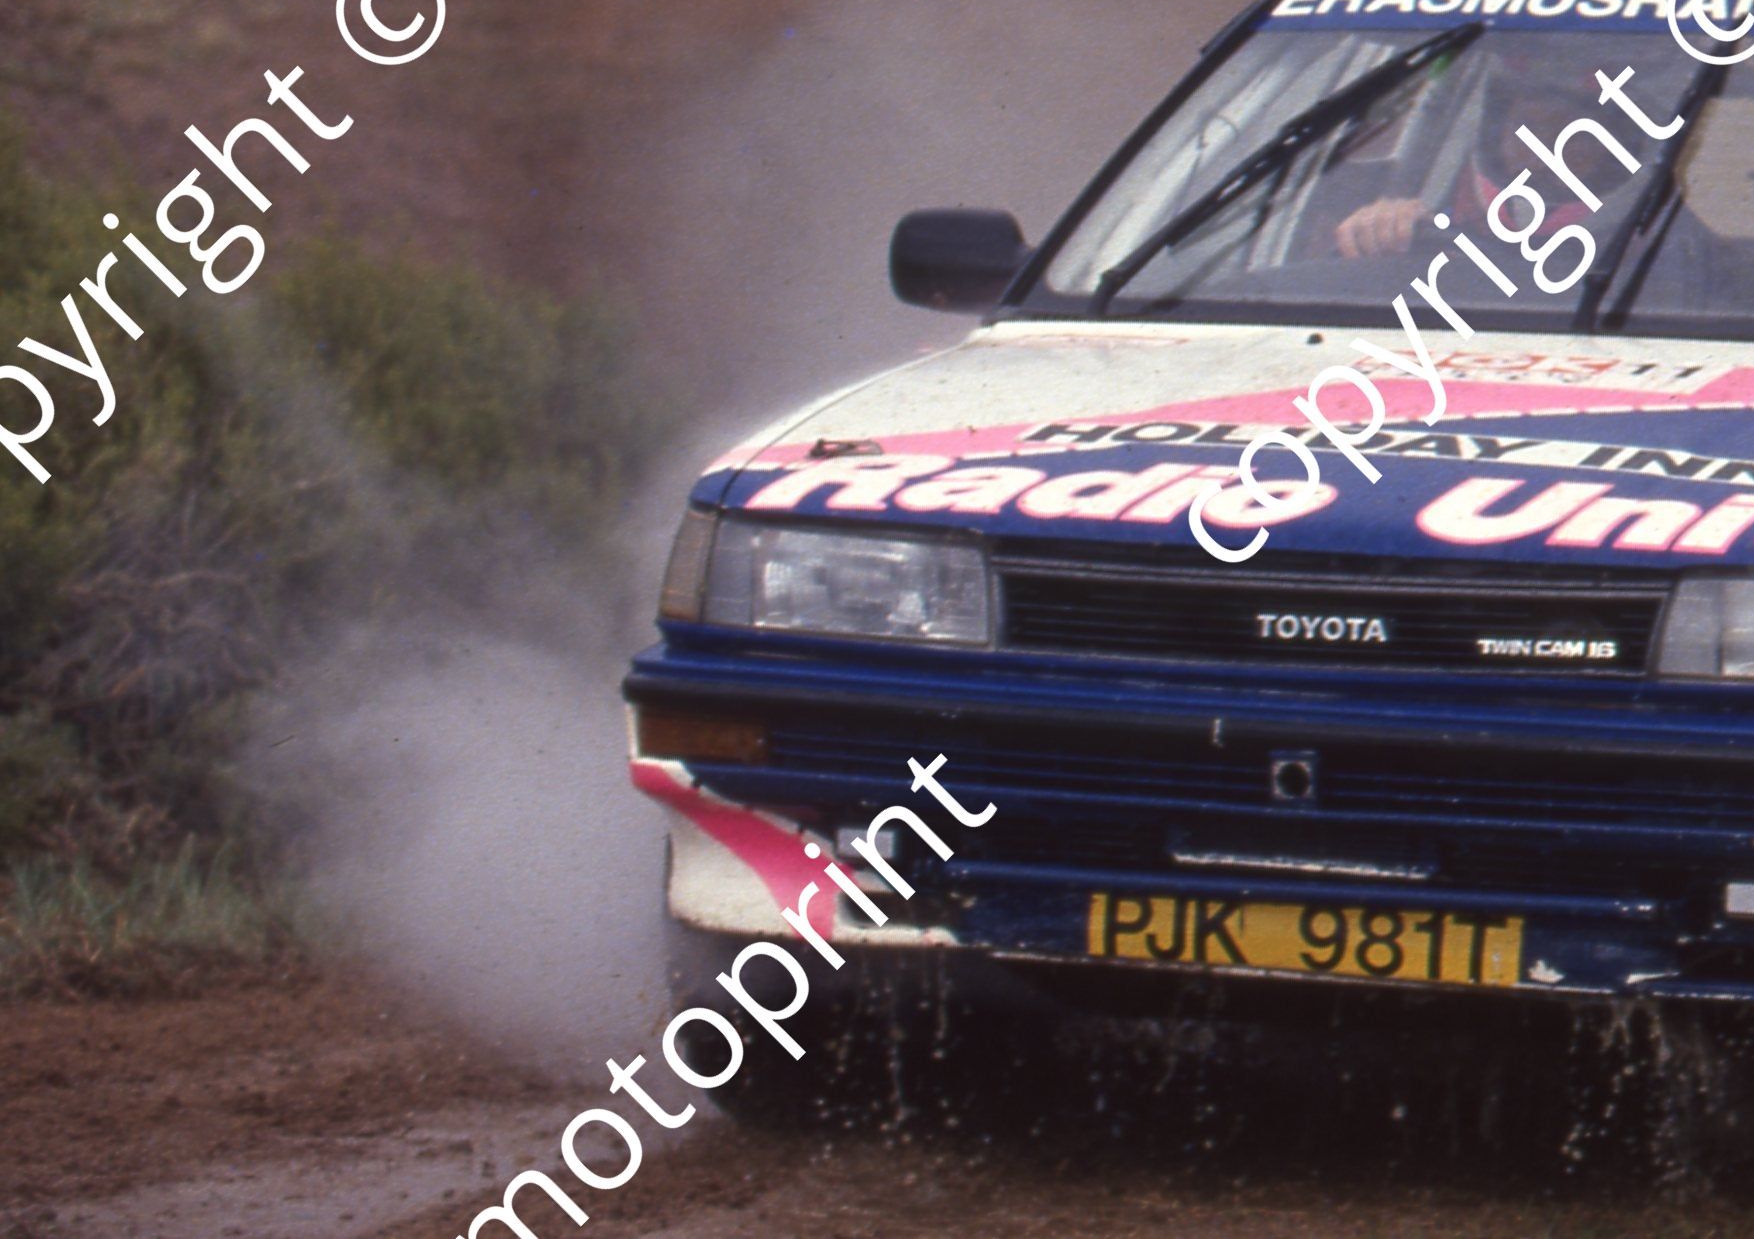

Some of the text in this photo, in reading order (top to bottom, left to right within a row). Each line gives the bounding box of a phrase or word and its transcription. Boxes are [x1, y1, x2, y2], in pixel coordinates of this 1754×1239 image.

[744, 453, 1340, 529] Radio
[1256, 612, 1388, 643] TOYOTA
[1477, 638, 1533, 656] TWIN
[1533, 639, 1586, 657] CAM
[1100, 895, 1503, 985] PJK 981T
